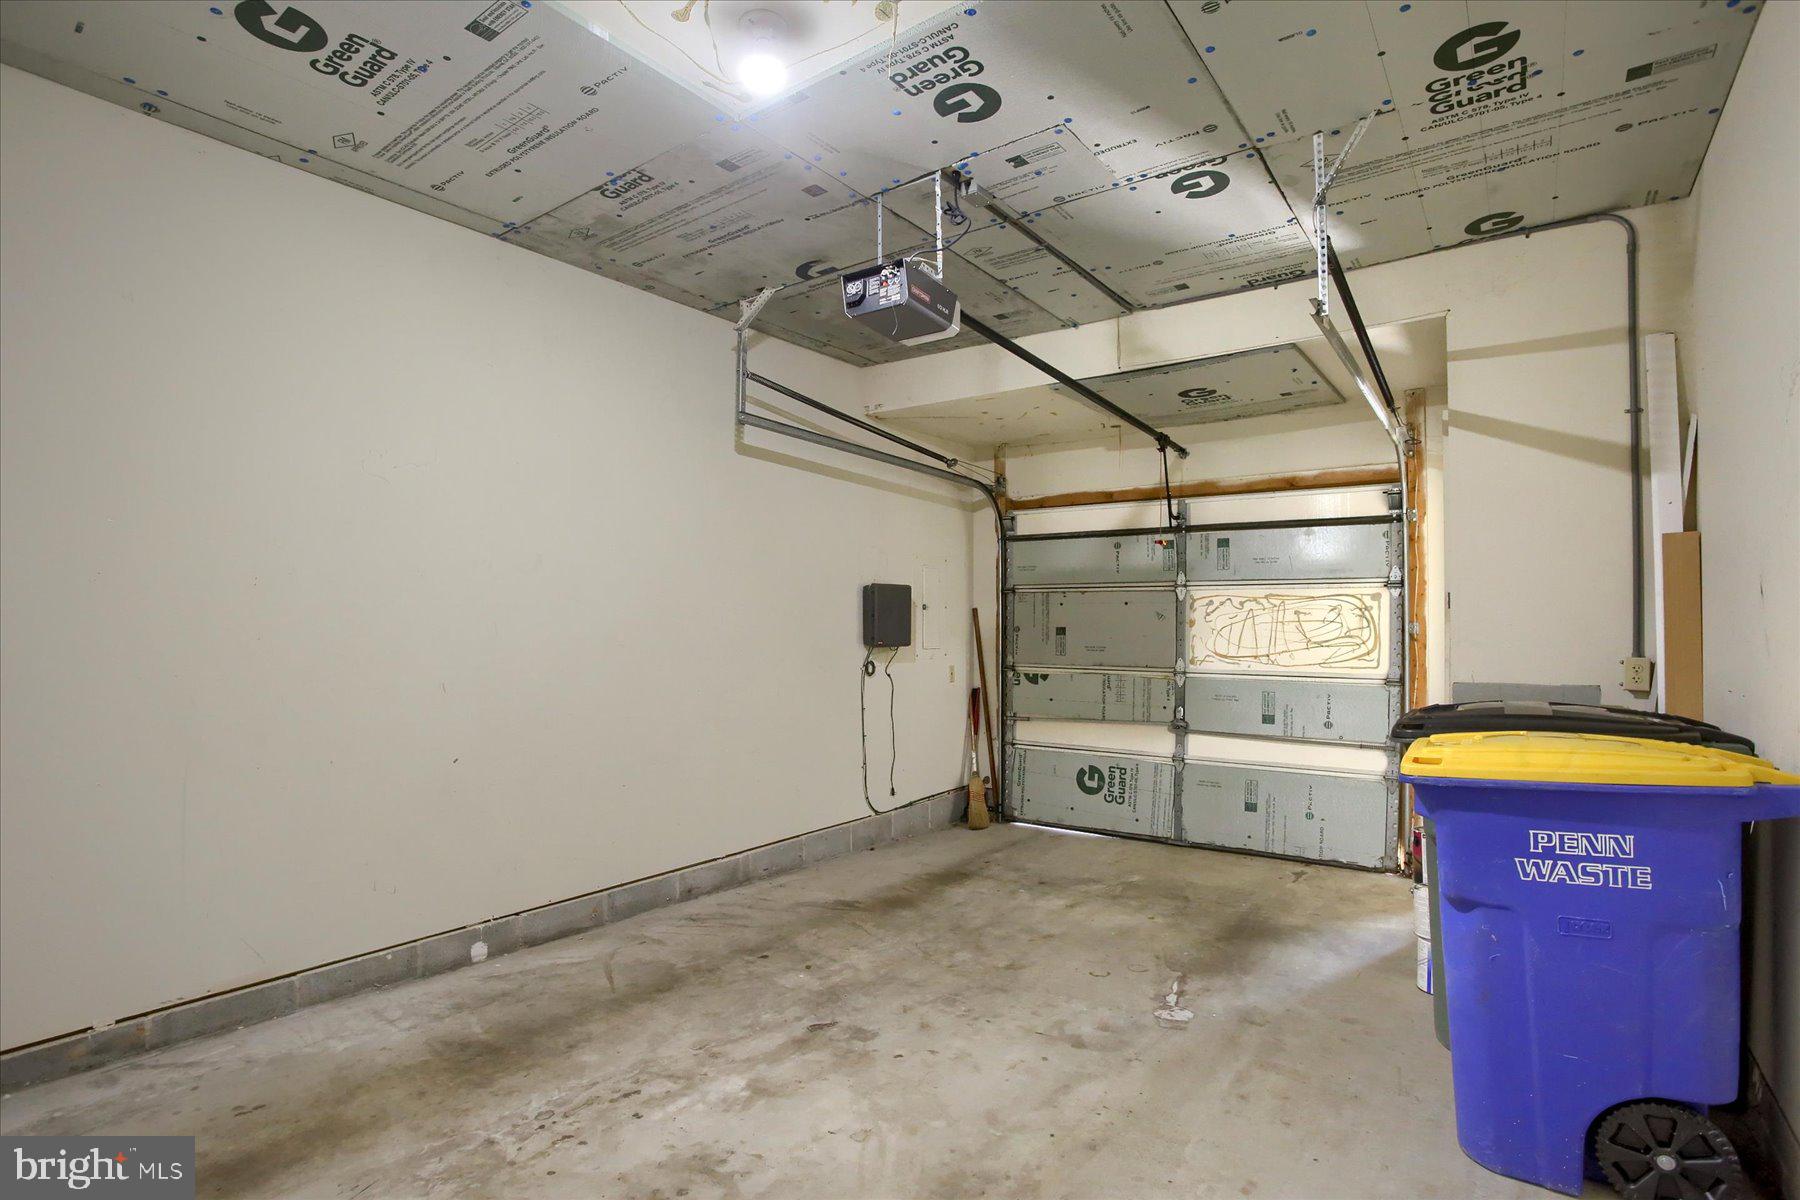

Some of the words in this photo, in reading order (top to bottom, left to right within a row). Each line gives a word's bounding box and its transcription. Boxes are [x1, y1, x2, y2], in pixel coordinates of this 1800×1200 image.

[309, 33, 369, 75] Green
[929, 34, 954, 49] ASTM
[1434, 21, 1521, 71] G
[338, 40, 398, 87] Guard
[594, 66, 628, 89] PACTIV
[889, 46, 970, 89] Guard
[904, 60, 984, 97] Green
[1425, 56, 1527, 93] Green
[933, 82, 1002, 123] G
[1431, 113, 1459, 124] ASTM
[600, 170, 654, 200] Guard
[1171, 170, 1230, 198] G
[1076, 765, 1105, 795] G
[1104, 765, 1116, 803] Green
[1115, 766, 1127, 805] Guard
[1529, 830, 1634, 859] PENN
[1514, 857, 1653, 890] WASTE
